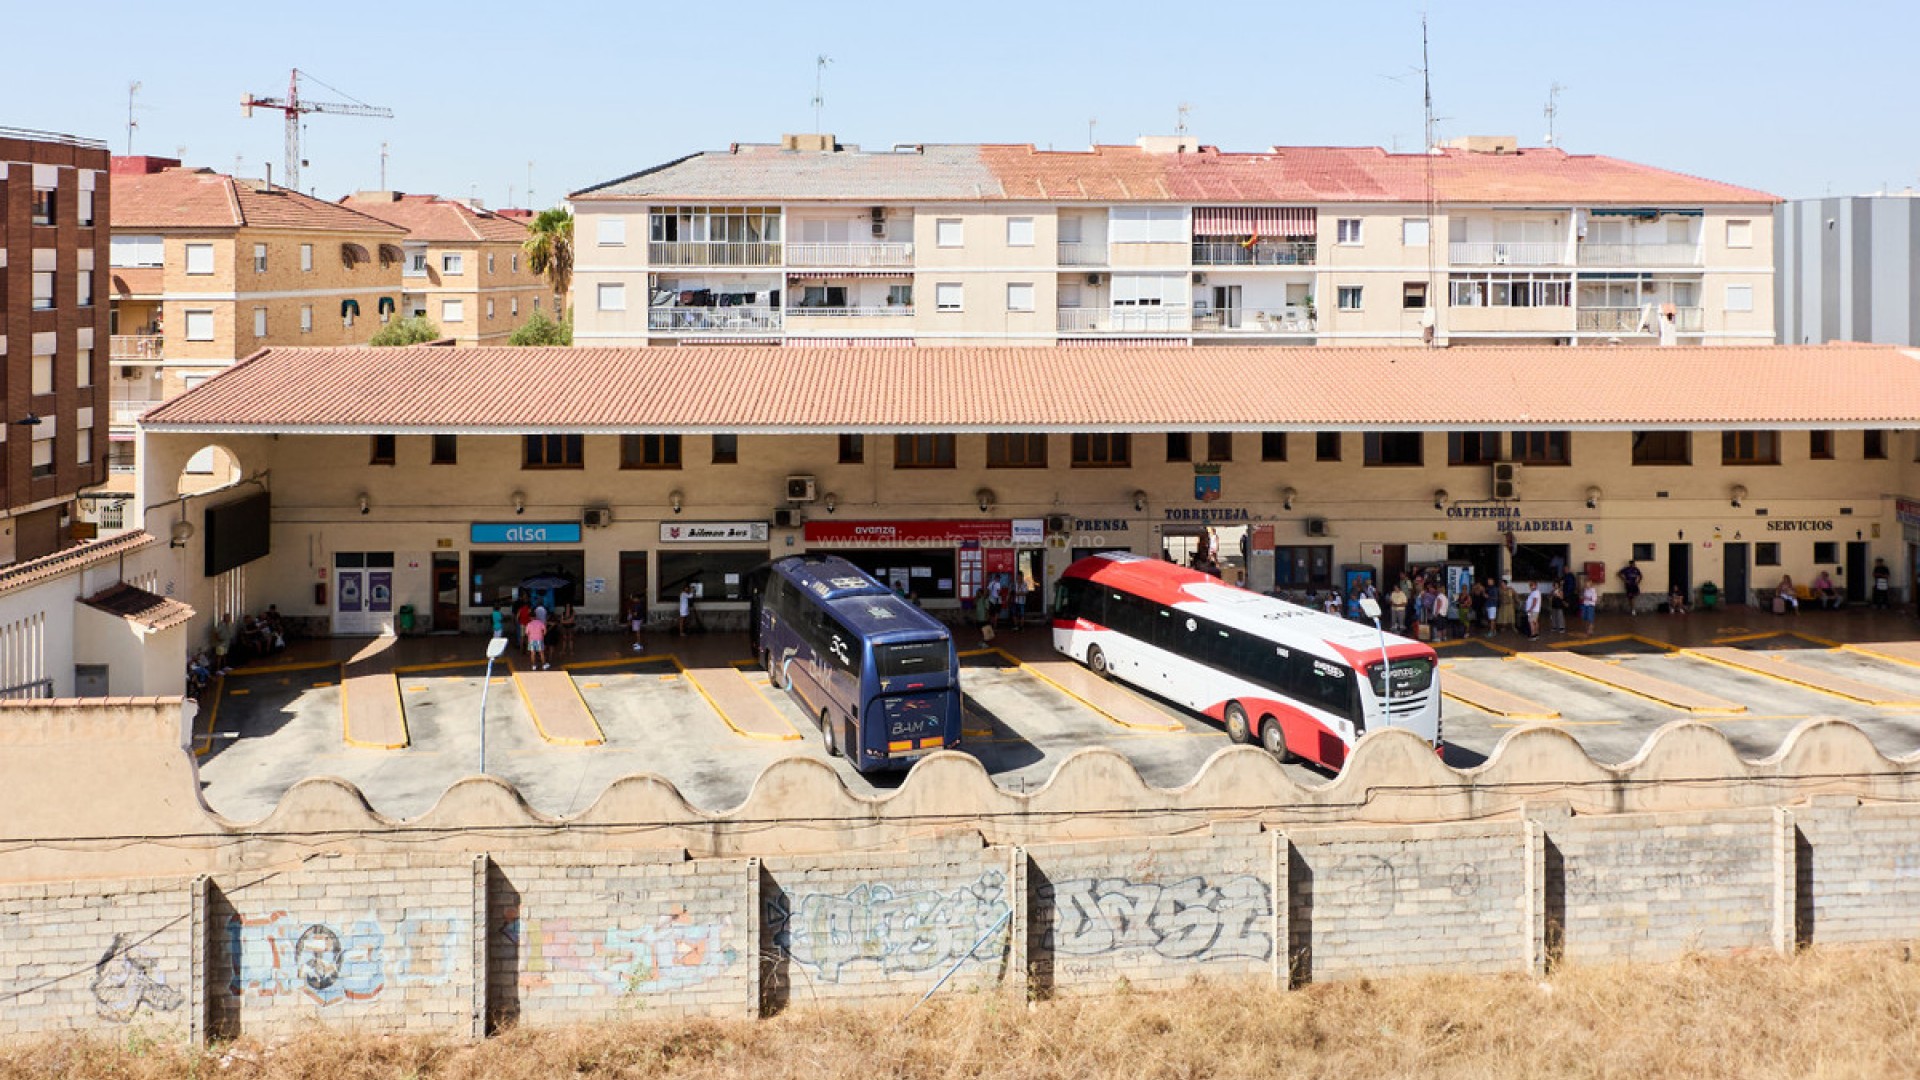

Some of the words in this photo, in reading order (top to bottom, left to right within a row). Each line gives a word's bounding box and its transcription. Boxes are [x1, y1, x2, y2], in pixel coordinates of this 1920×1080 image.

[1164, 508, 1249, 520] TORREVIEJA
[1447, 507, 1520, 517] CAFETERIA
[855, 526, 896, 535] avanza
[1076, 519, 1129, 531] PRENSA
[1497, 520, 1573, 531] HELADERIA
[1767, 520, 1833, 531] SERVICIOS
[506, 526, 547, 541] alsa
